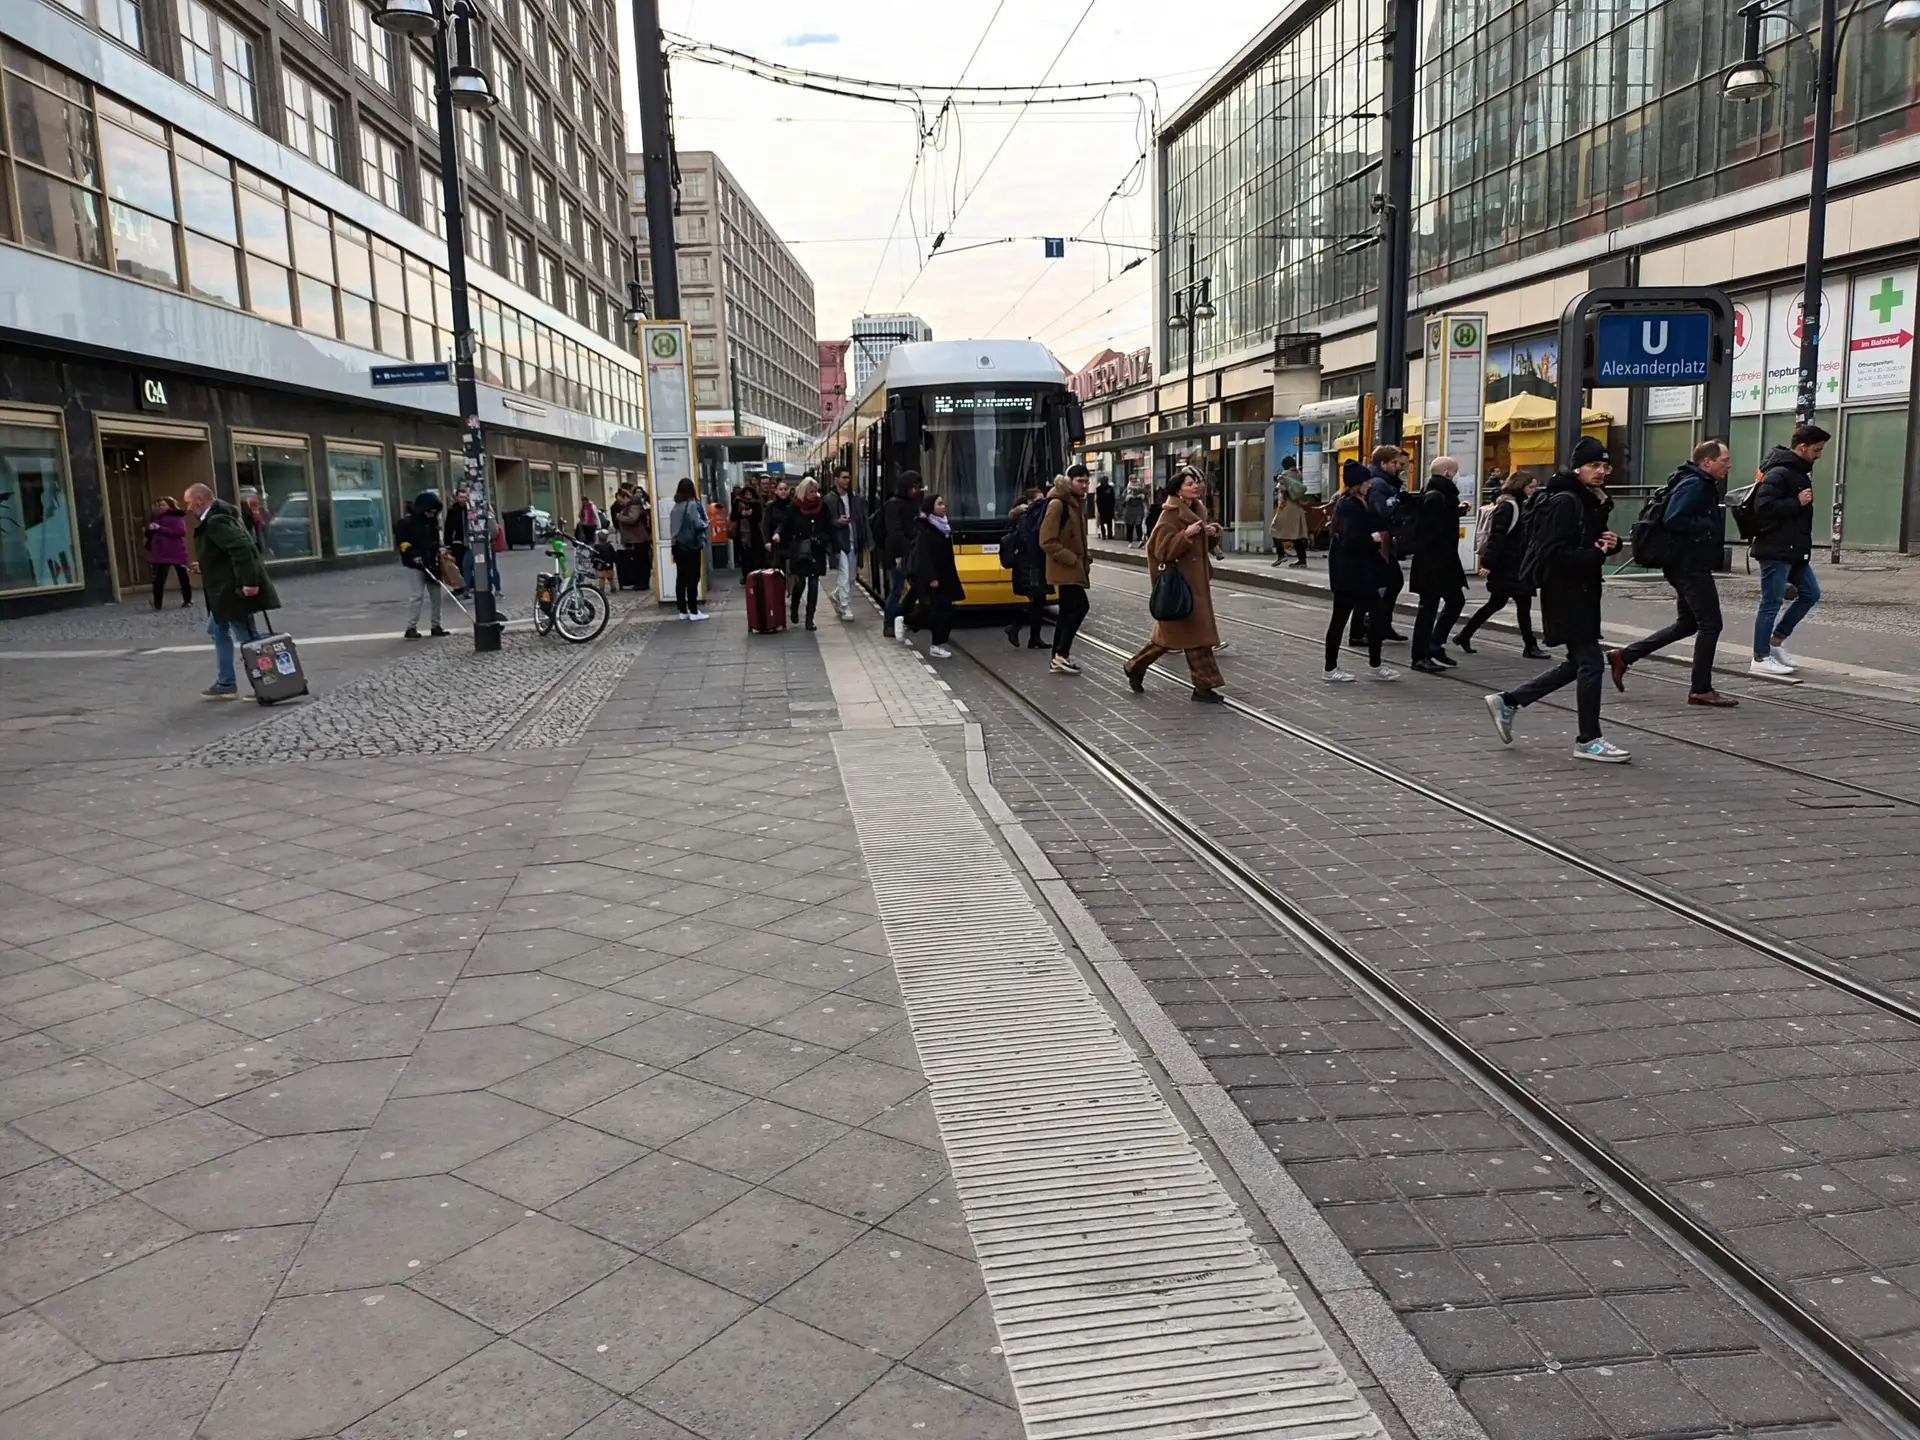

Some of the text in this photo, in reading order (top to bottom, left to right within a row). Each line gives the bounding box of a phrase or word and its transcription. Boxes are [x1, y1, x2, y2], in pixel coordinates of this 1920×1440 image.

[1642, 320, 1668, 355] U
[1870, 336, 1899, 347] Bahnhof
[1601, 358, 1705, 377] Alexanderplatz
